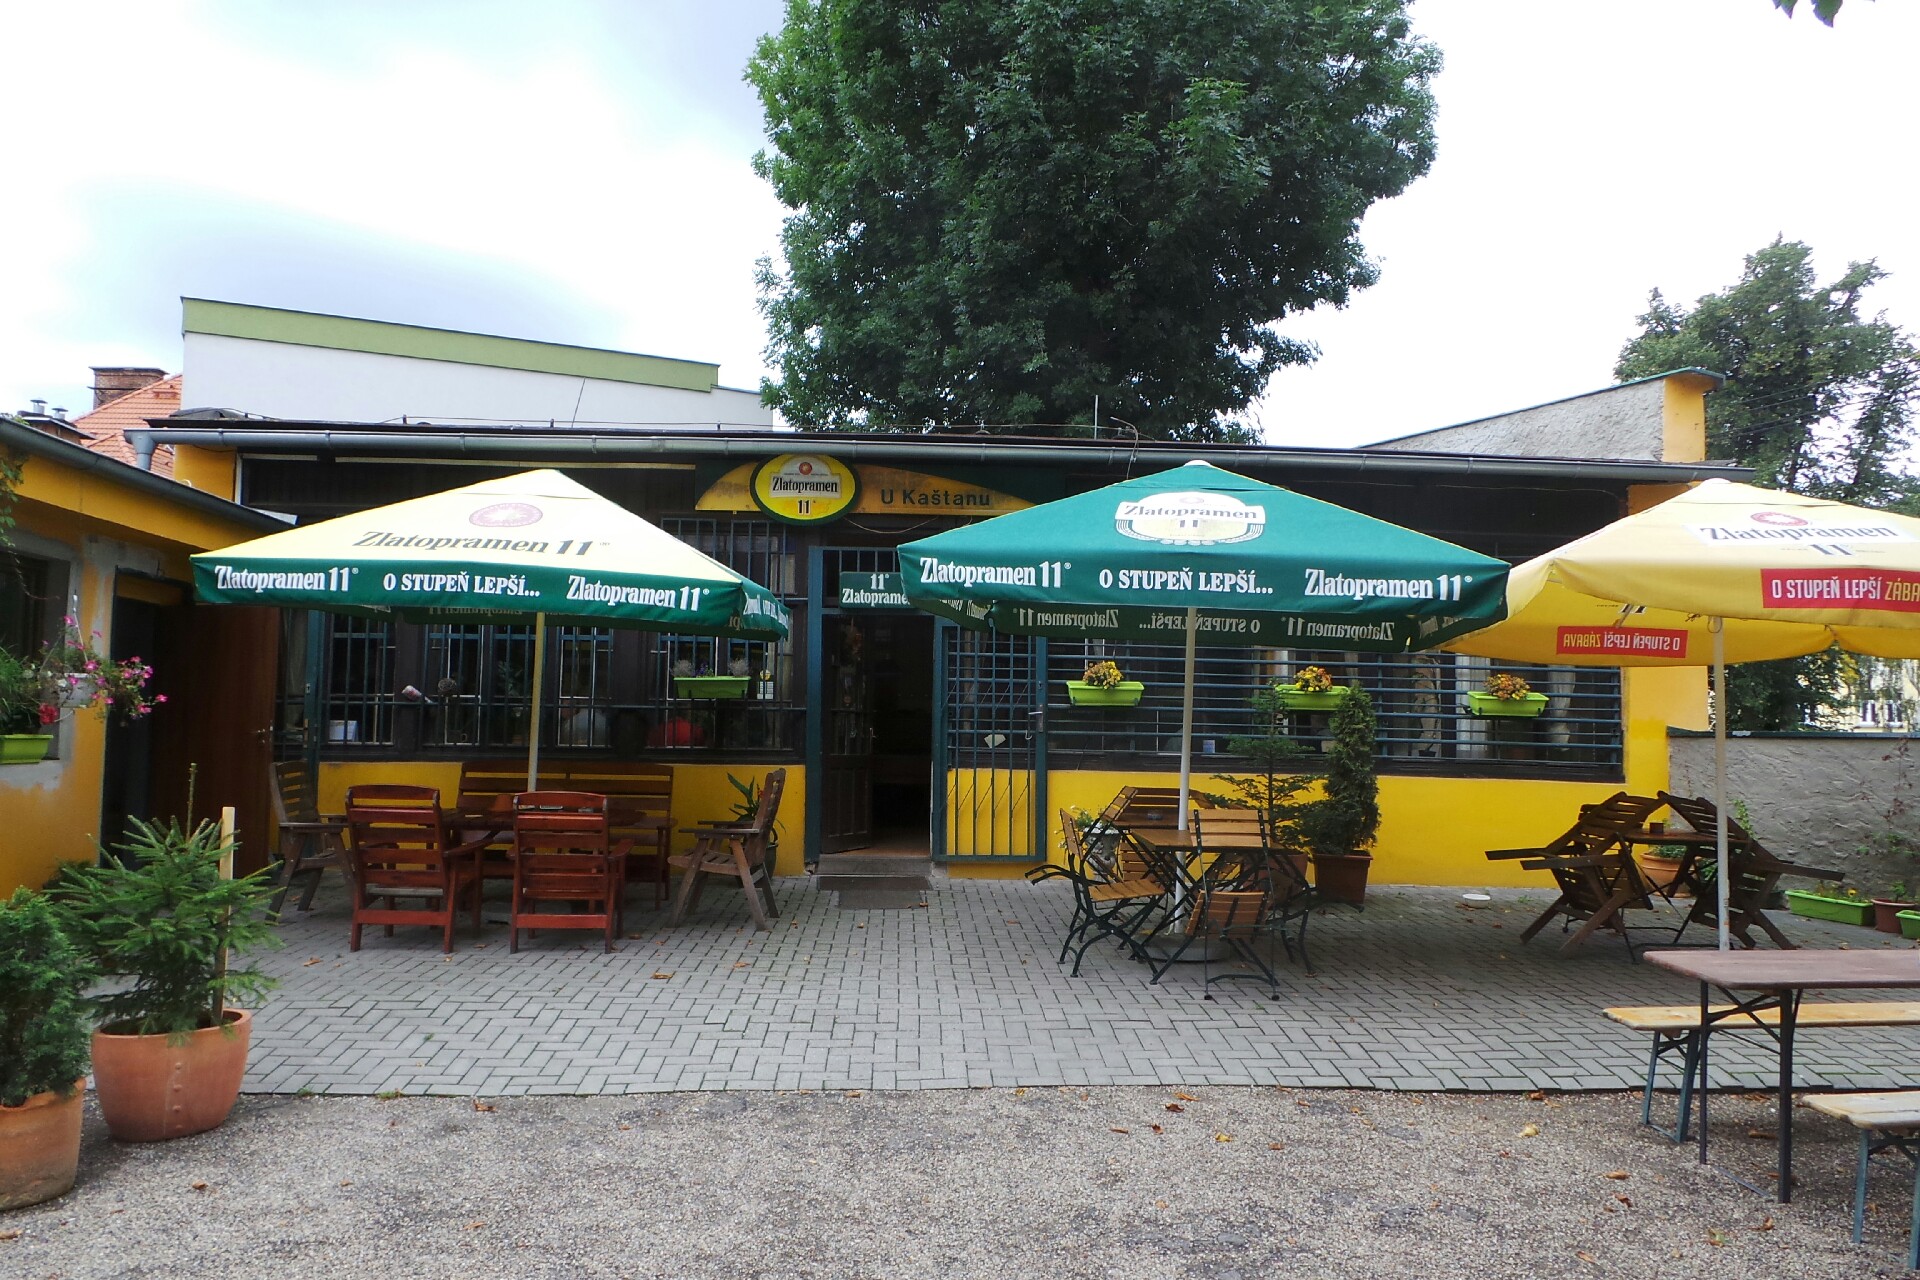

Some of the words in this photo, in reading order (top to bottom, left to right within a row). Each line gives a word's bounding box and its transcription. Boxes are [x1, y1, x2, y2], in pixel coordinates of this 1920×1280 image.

[772, 476, 839, 493] Zlatopramen
[881, 489, 894, 504] U
[902, 489, 991, 506] Kaštanu
[1124, 505, 1257, 519] Zlatopramen
[352, 531, 550, 553] Zlatopramen
[555, 539, 594, 556] 11
[1699, 525, 1899, 541] Zlatopramen
[214, 565, 326, 593] Zlatopramen
[383, 572, 397, 591] O
[400, 570, 470, 593] STUPEŇ
[473, 573, 541, 597] LEPŠÍ...
[920, 556, 1037, 588] Zlatopramen
[1099, 570, 1113, 589] O
[1118, 567, 1193, 591] STUPEŇ
[1198, 569, 1274, 595] LEPŠÍ...
[1304, 568, 1434, 600] Zlatopramen
[566, 575, 676, 607] Zlatopramen
[841, 588, 910, 607] Zlatoprame
[1772, 579, 1782, 599] O
[1786, 575, 1840, 600] STUPEŇ
[1844, 576, 1883, 600] LEPŠÍ
